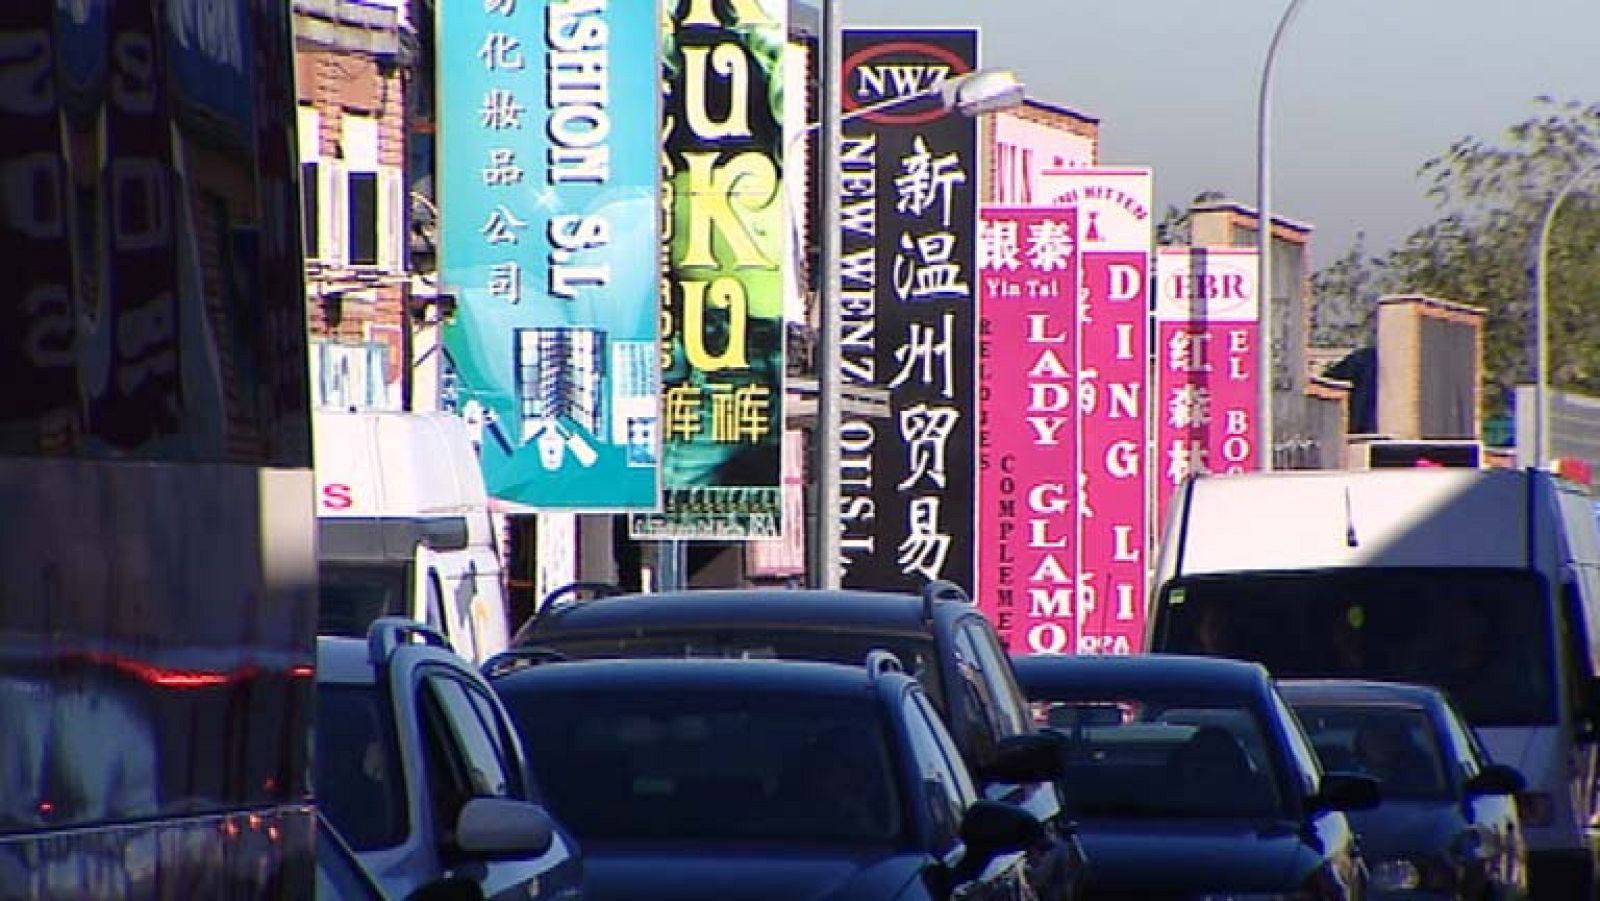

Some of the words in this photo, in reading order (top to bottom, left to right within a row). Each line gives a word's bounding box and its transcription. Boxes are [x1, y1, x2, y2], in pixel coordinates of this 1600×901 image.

[856, 65, 951, 97] NWZ
[840, 133, 877, 234] NEW
[987, 279, 1021, 297] Yin
[840, 246, 877, 488] WENZOU
[889, 135, 970, 580] 新温州贸易
[1026, 314, 1073, 446] LADY
[1106, 263, 1141, 479] DING
[1222, 410, 1250, 475] BO
